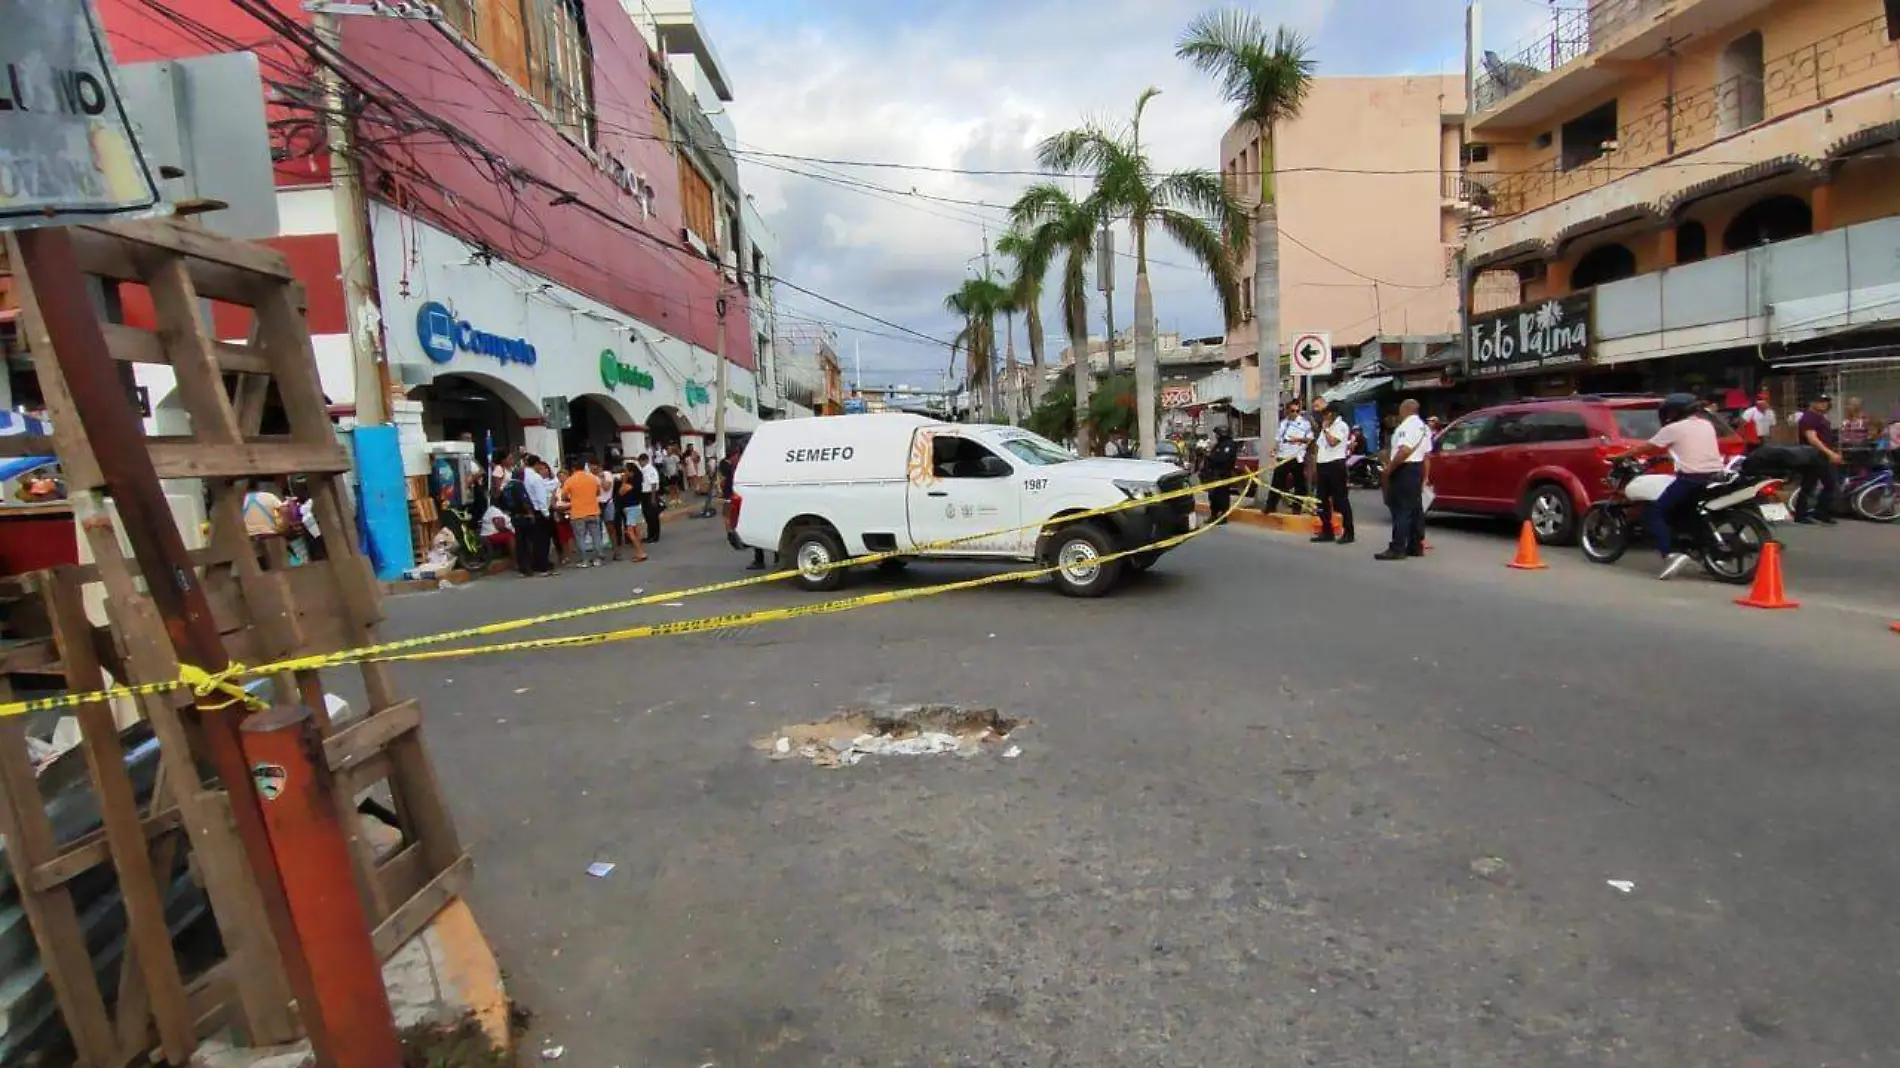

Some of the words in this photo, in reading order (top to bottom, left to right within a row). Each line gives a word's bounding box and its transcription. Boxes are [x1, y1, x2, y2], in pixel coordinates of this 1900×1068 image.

[1471, 319, 1514, 362] Foto
[1519, 300, 1588, 357] Palma
[785, 446, 854, 462] SEMEFO
[1024, 478, 1048, 490] 1987
